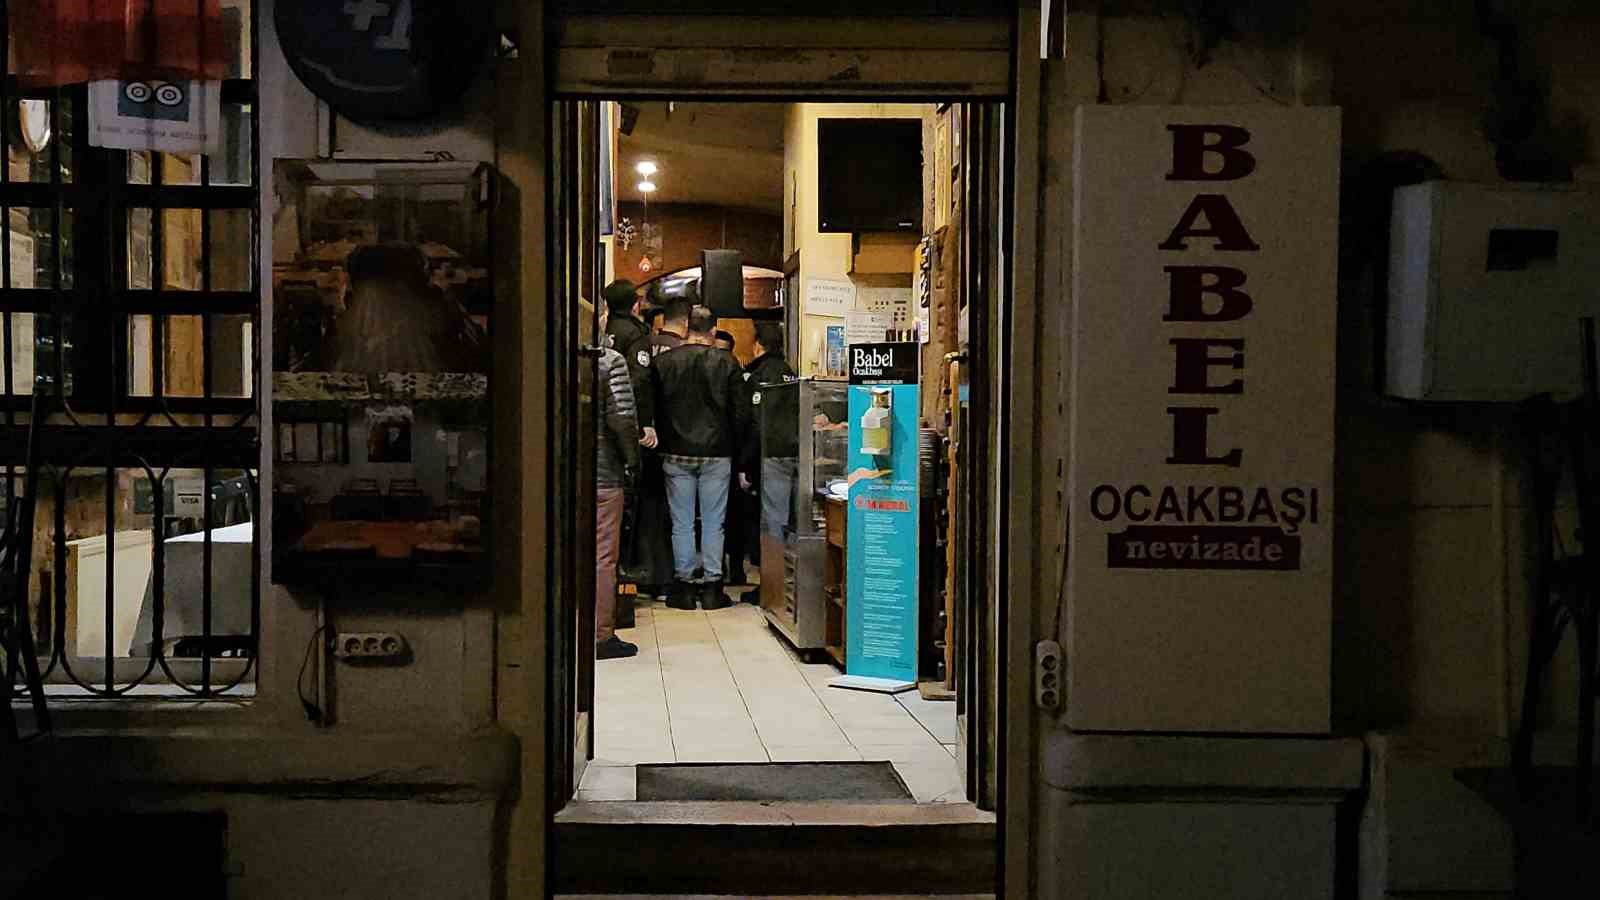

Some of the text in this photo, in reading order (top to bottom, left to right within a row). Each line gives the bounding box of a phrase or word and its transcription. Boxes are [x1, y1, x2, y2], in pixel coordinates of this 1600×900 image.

[1158, 124, 1260, 467] BABEL
[853, 348, 893, 367] Babel
[1090, 485, 1318, 533] OCAKBAŞI
[1124, 534, 1284, 562] nevizade
